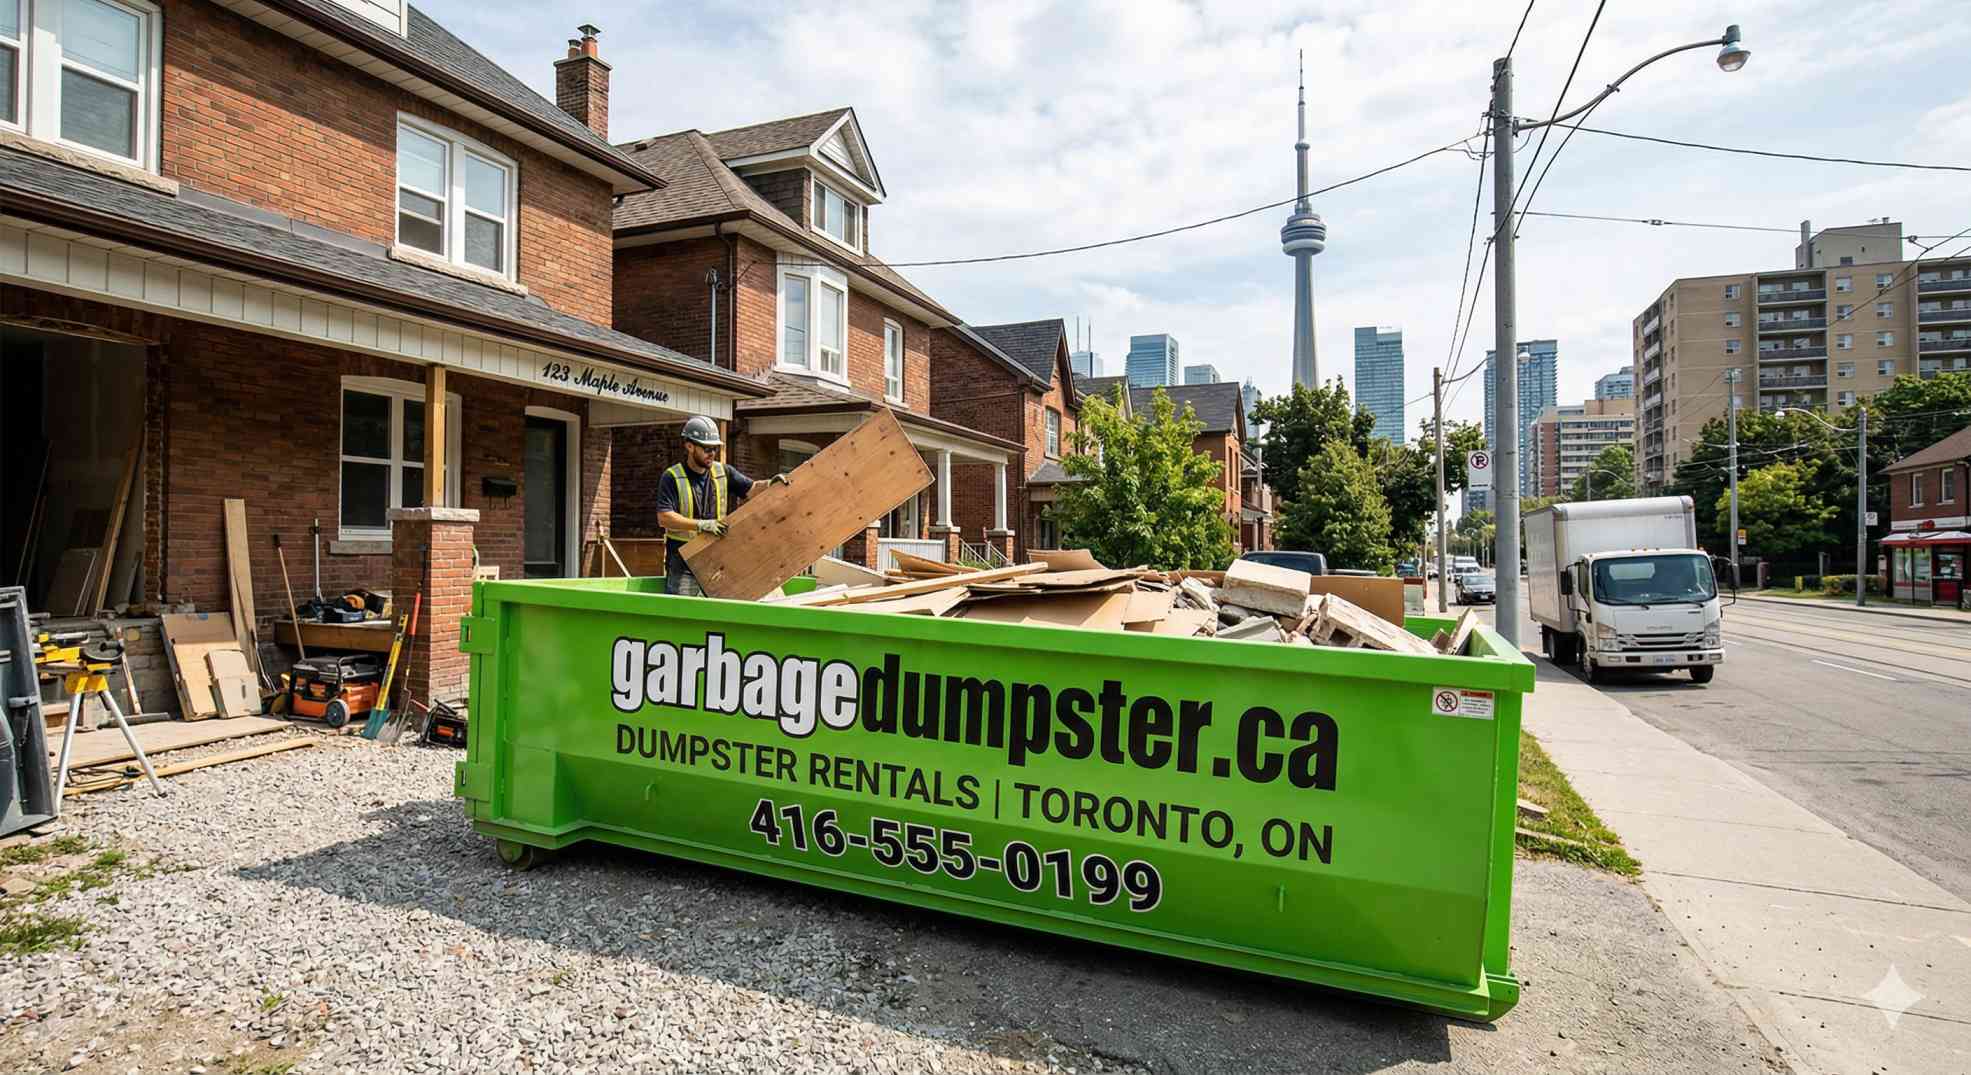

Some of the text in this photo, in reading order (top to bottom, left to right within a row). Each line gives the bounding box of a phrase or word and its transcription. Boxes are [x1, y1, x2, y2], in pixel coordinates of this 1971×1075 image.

[542, 361, 669, 402] 123 Maple Avenue
[611, 632, 1338, 791] garbagedumpster.ca
[616, 723, 798, 783] DUMPSTER
[809, 752, 980, 810] RENTALS
[1014, 782, 1244, 858] TORONTO,
[1261, 818, 1334, 864] ON
[750, 799, 1163, 912] 416-555-0199
